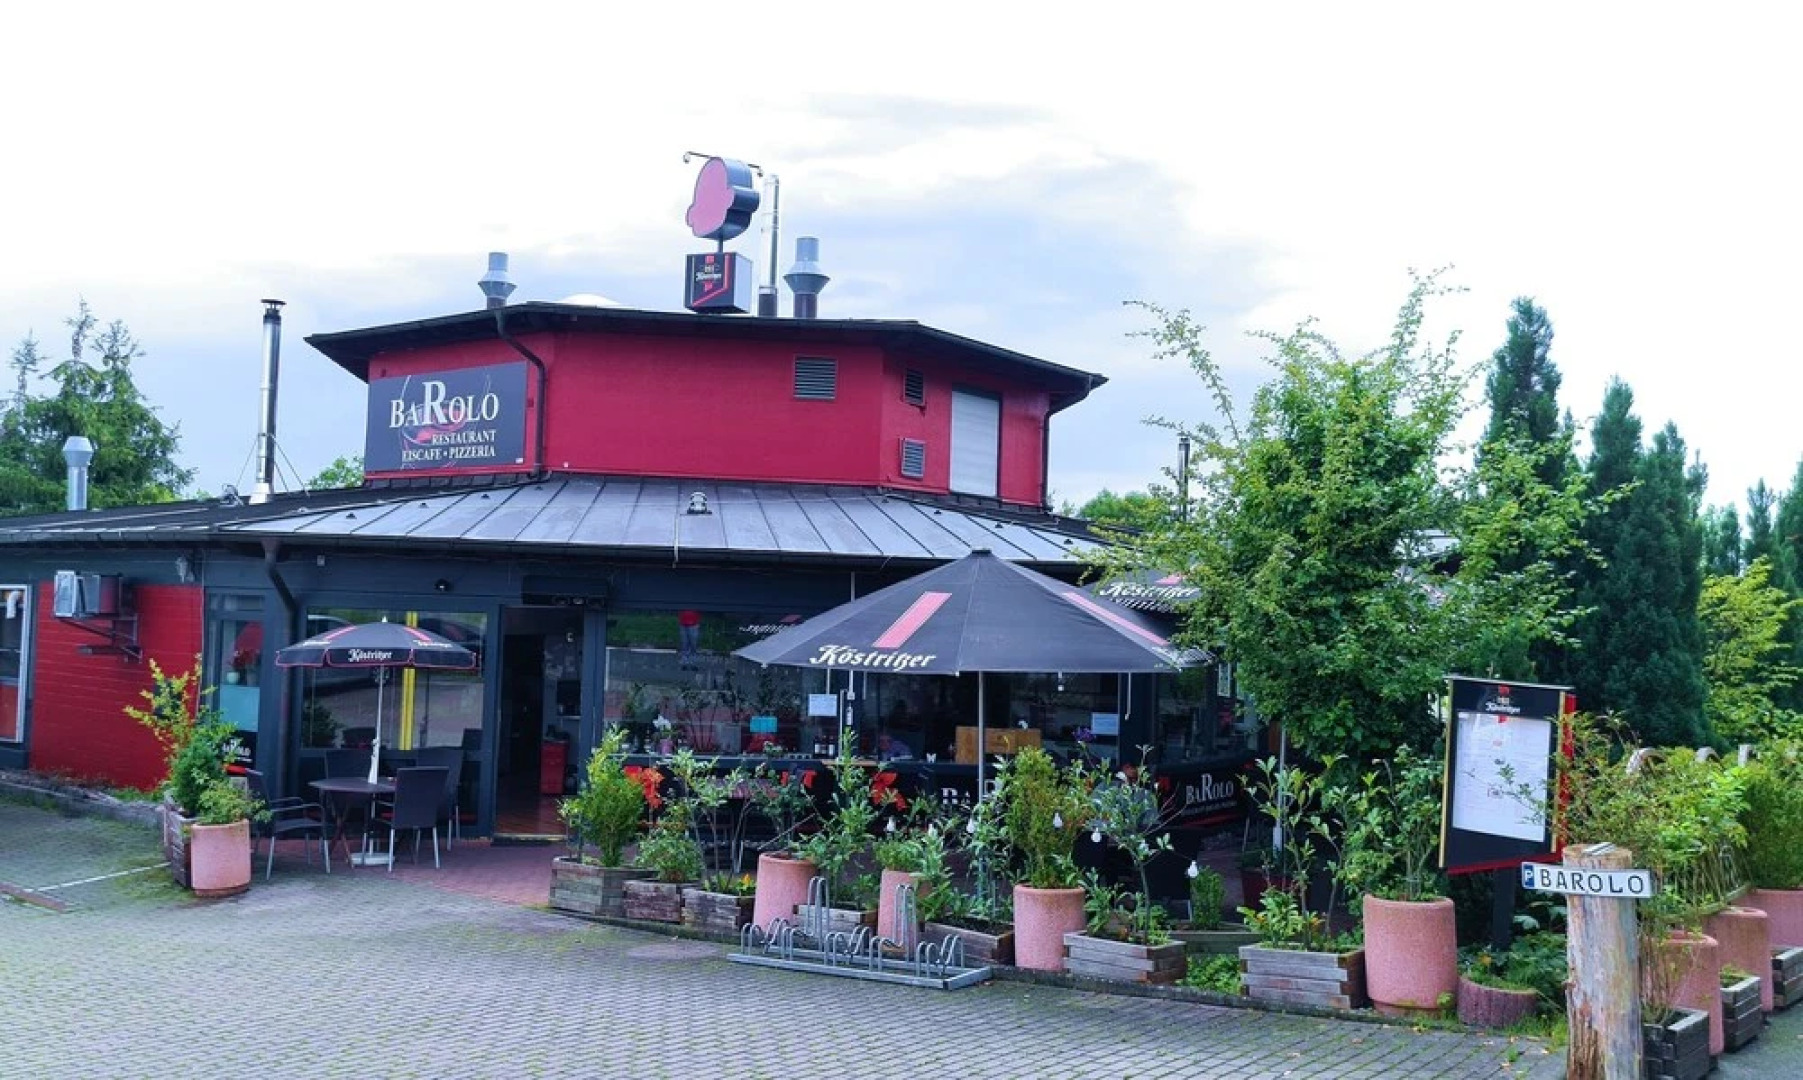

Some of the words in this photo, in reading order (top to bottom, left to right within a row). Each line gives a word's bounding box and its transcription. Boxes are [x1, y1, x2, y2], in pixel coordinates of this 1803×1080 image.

[389, 380, 499, 428] BAROLO
[432, 429, 497, 446] RESTAURANT
[449, 445, 496, 459] PIZZERIA
[1540, 869, 1644, 893] BAROLO
